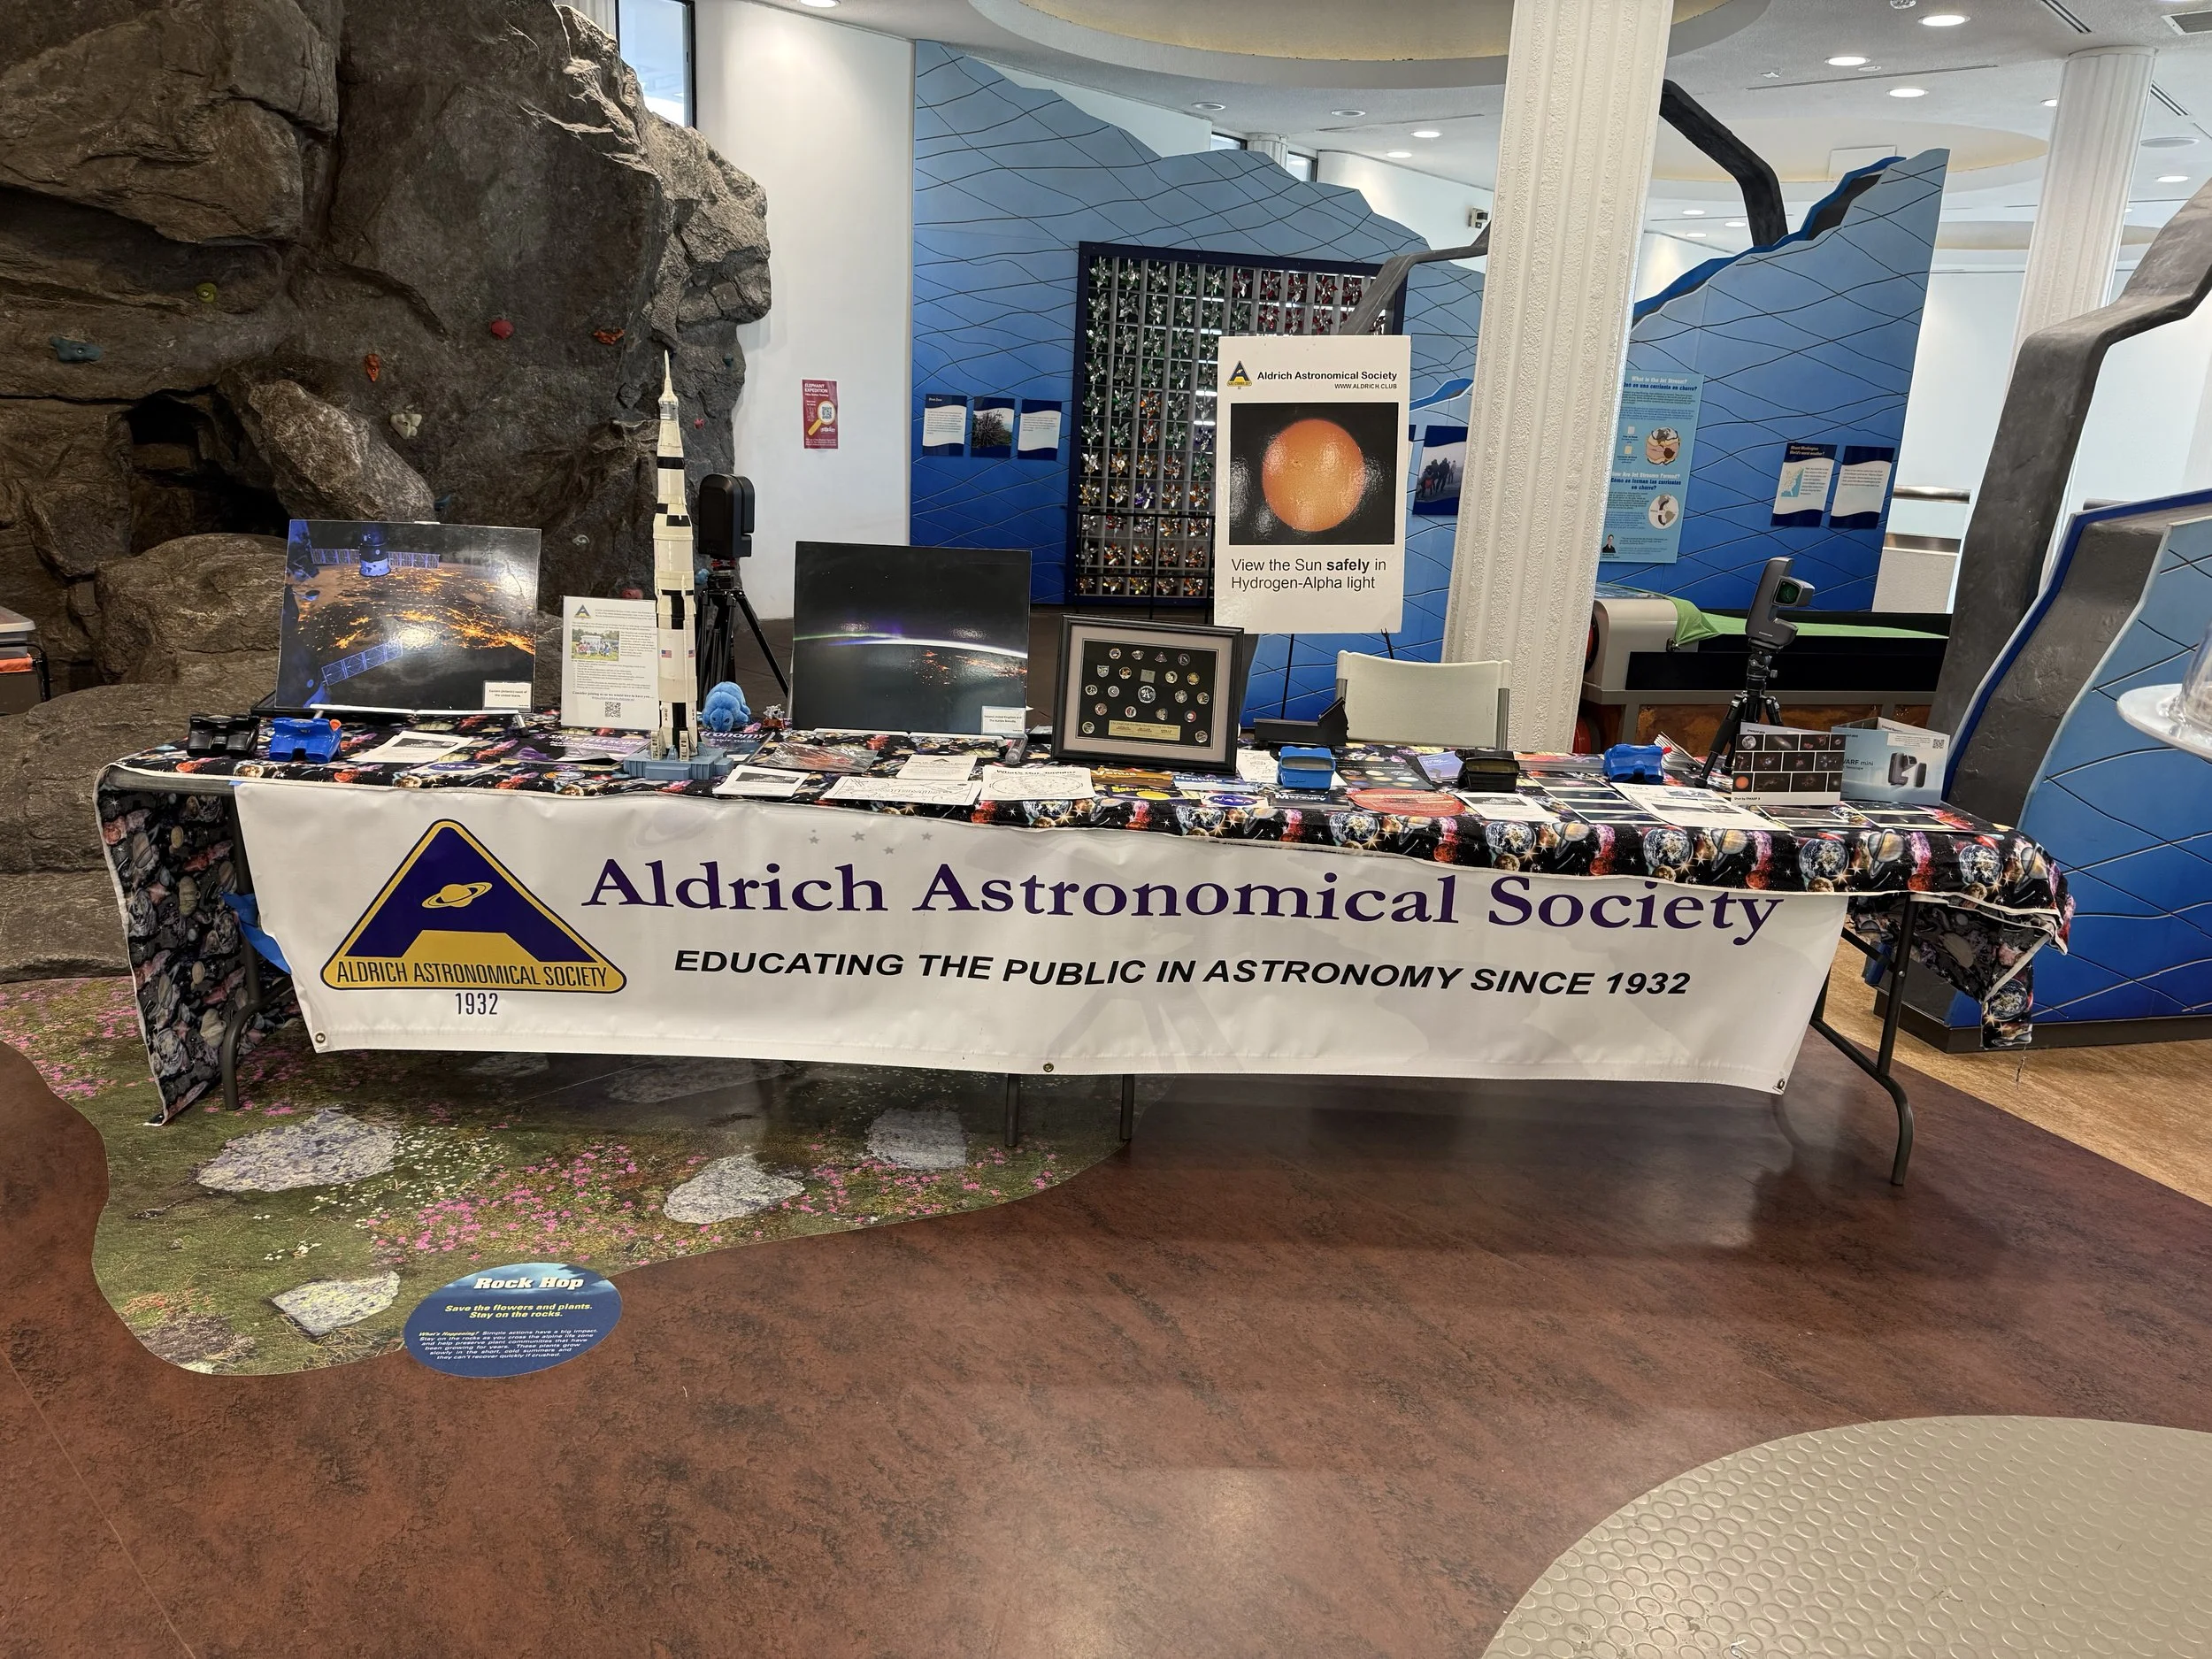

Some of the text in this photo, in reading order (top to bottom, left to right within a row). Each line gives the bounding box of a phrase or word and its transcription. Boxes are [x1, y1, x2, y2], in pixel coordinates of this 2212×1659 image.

[1294, 372, 1359, 380] Astronomical
[1361, 372, 1397, 381] Society
[1232, 558, 1386, 574] View the Sun safely in
[1232, 576, 1375, 592] Hydrogen-Alpha light
[700, 731, 768, 740] tronomy
[580, 858, 1785, 946] Aldrich Astronomical Society
[336, 961, 608, 987] ALDRICH ASTRONOMICAL SOCIETY
[674, 949, 1692, 995] EDUCATING THE PUBLIC IN ASTRONOMY SINCE 1932
[455, 992, 499, 1016] 1932
[473, 1277, 584, 1291] Rock Hop
[557, 1302, 593, 1311] plants.
